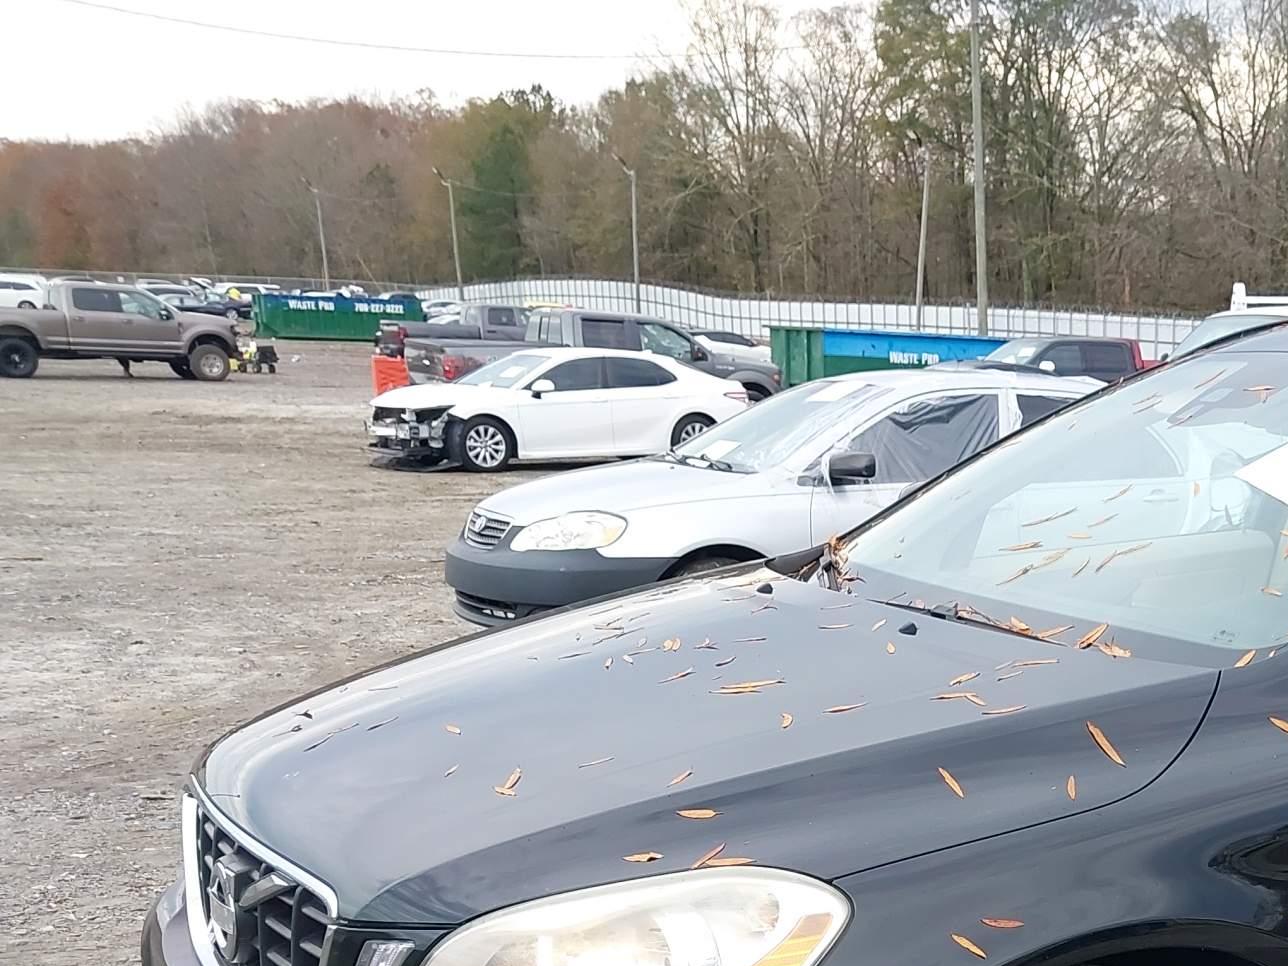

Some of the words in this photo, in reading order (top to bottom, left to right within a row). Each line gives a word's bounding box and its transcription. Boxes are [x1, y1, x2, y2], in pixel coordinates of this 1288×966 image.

[288, 299, 317, 311] WASTE
[889, 350, 919, 365] WASTE
[921, 352, 940, 366] PRO
